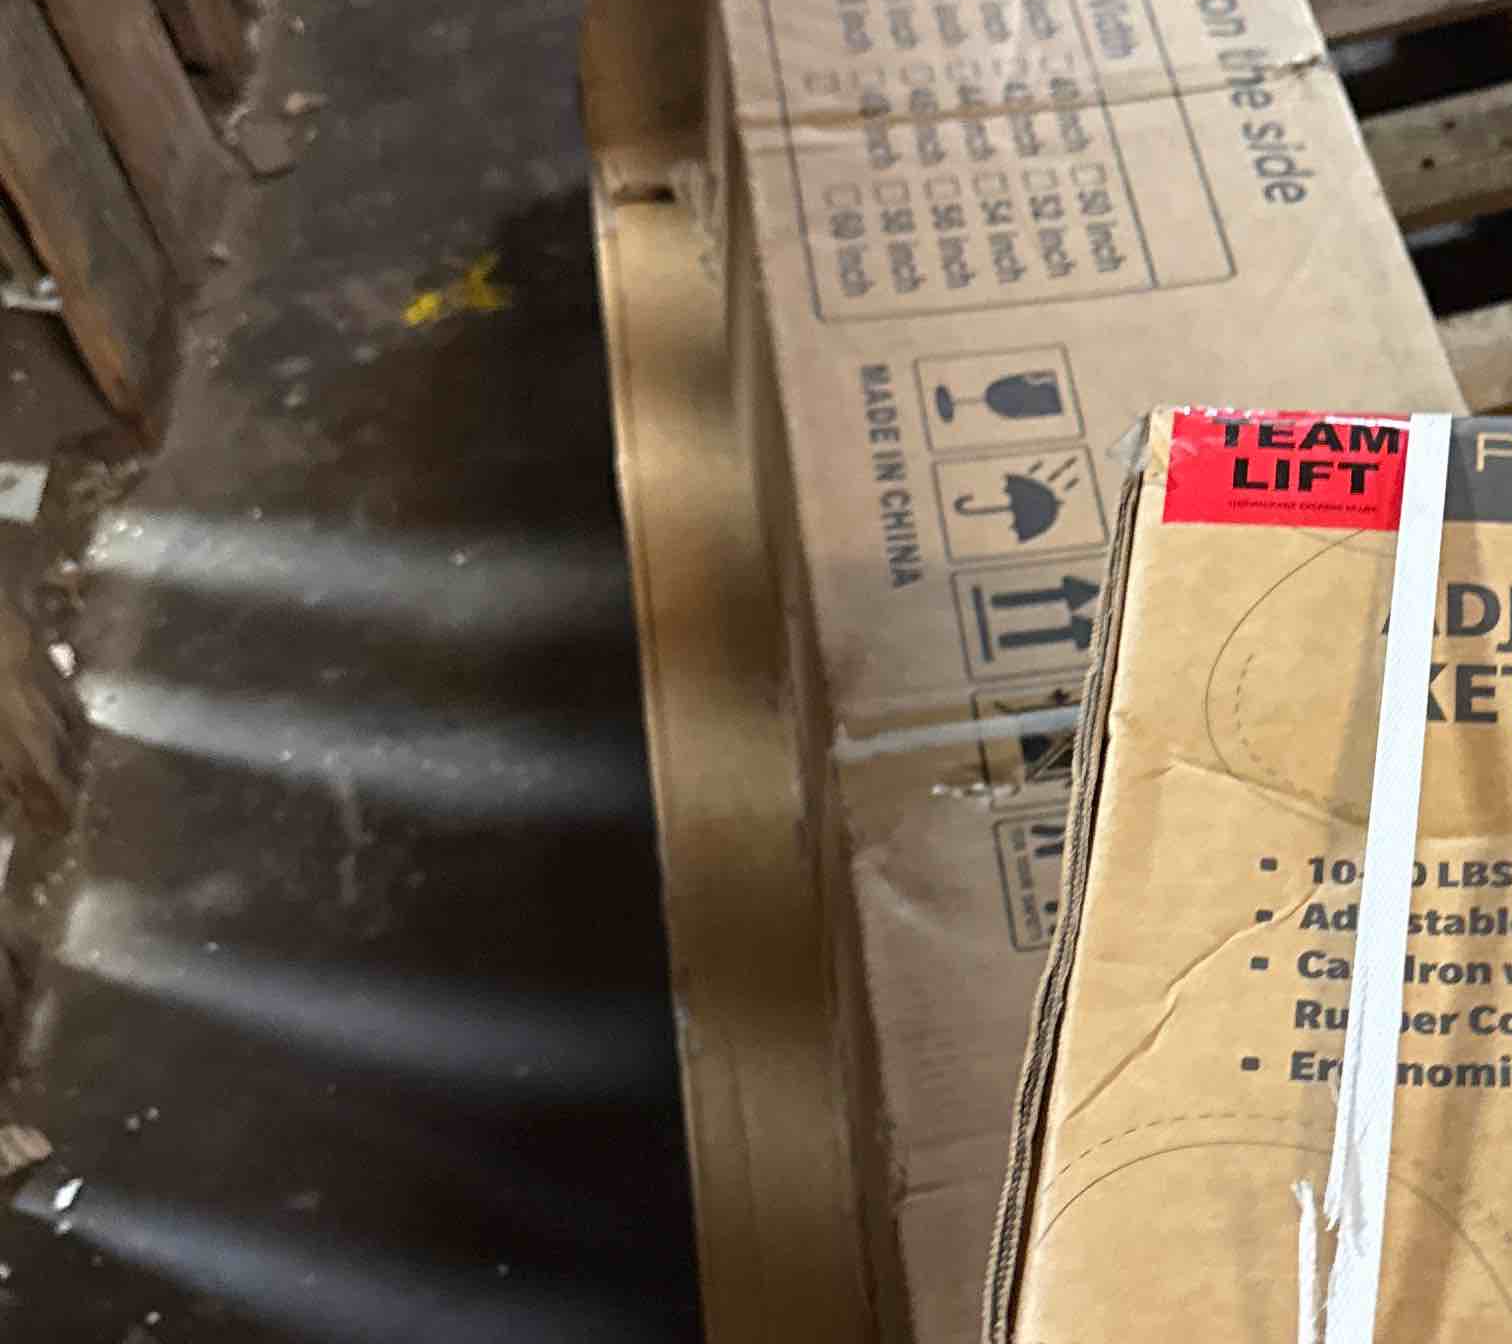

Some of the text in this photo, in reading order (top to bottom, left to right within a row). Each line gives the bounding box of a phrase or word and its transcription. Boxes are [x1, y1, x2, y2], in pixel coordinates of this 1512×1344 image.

[1217, 47, 1272, 110] the
[1243, 122, 1314, 207] side
[837, 244, 875, 297] inch
[888, 241, 927, 294] inch
[938, 235, 976, 290] inch
[987, 231, 1026, 285] inch
[1037, 226, 1077, 279] inch
[1085, 221, 1126, 273] inch
[1213, 420, 1400, 455] TEAM
[861, 363, 924, 588] MADE IN CHINA
[1232, 457, 1380, 495] LIFT
[1404, 955, 1492, 986] Iron
[1294, 999, 1459, 1035] Ruer
